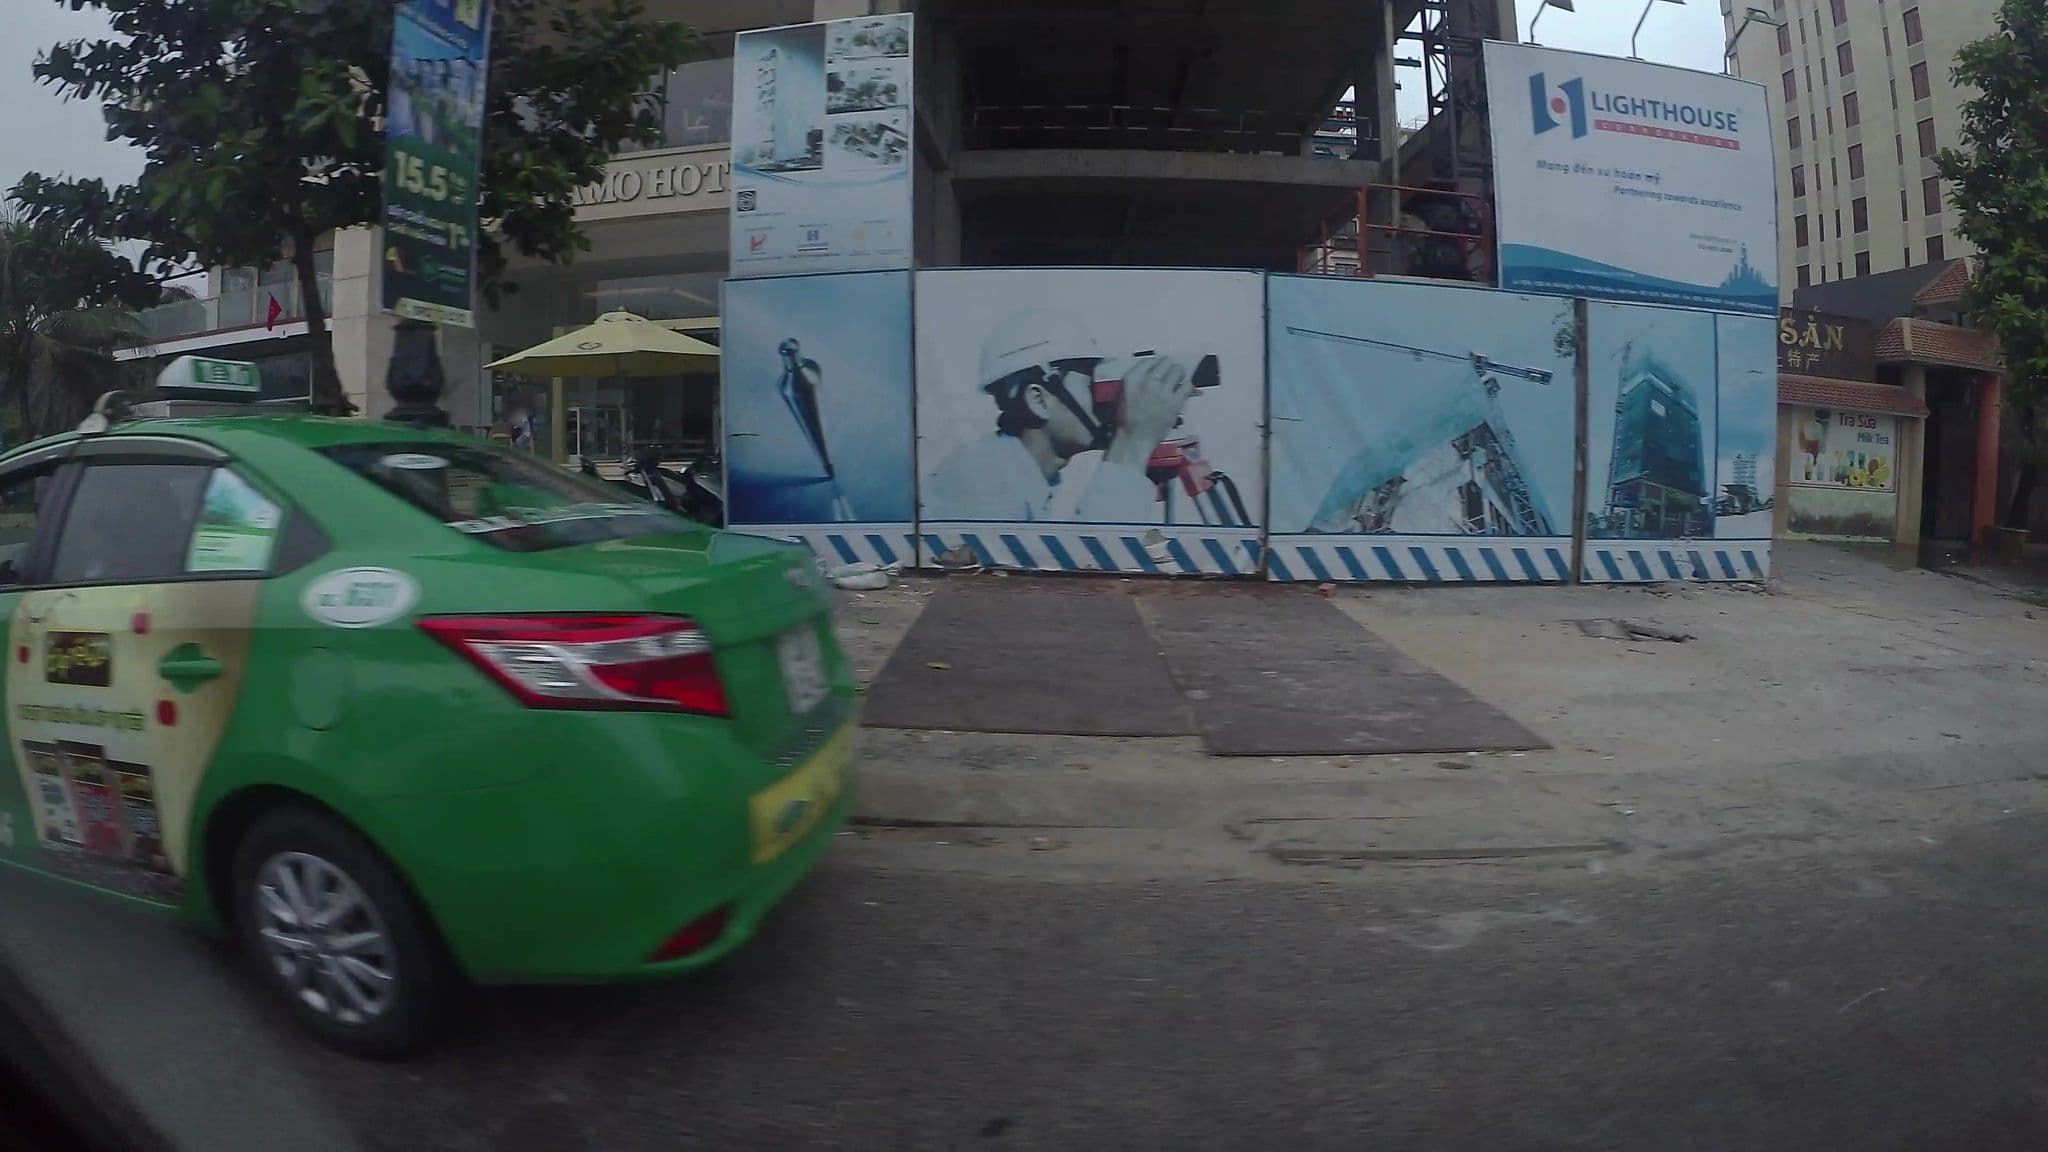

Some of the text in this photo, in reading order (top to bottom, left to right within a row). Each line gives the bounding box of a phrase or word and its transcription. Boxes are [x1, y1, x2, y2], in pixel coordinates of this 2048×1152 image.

[1591, 91, 1739, 132] LIGHTHOUSE
[646, 160, 732, 199] HOT
[1875, 434, 1889, 446] Tea
